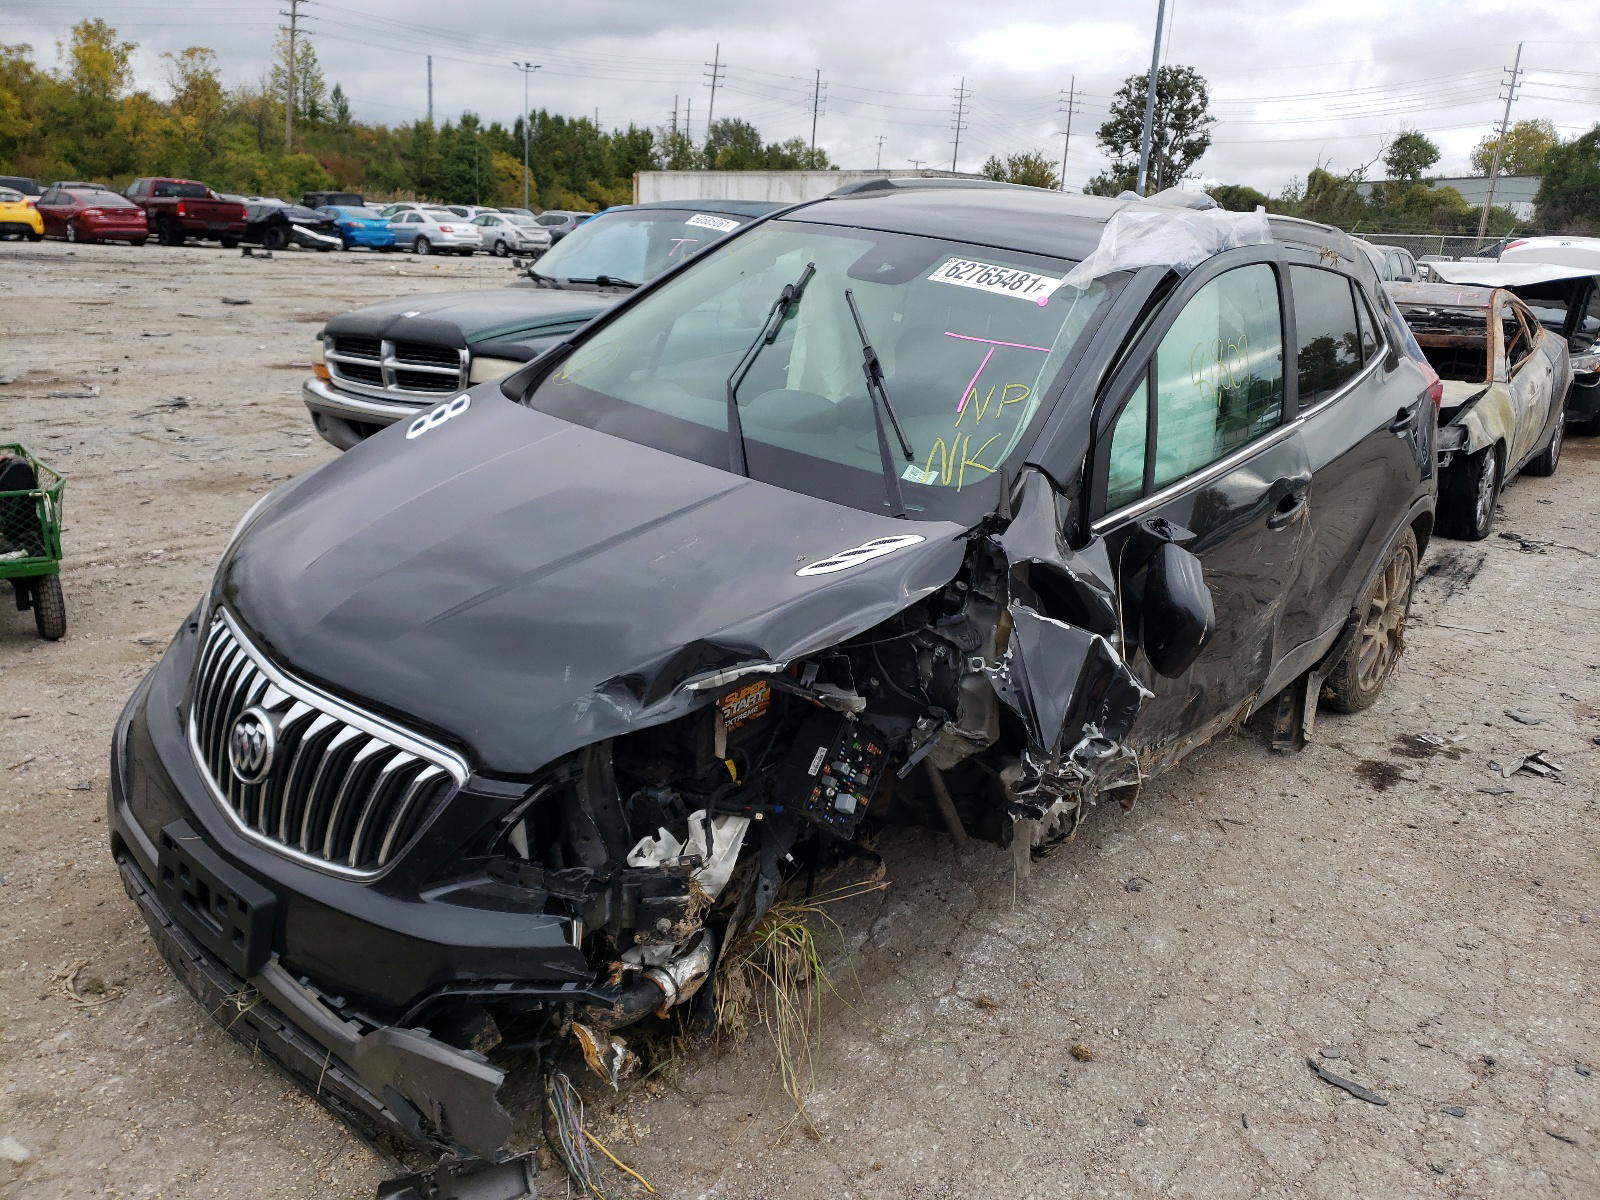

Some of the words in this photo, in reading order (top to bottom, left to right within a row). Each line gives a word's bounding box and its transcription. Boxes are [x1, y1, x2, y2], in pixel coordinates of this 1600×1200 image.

[944, 331, 1053, 413] T
[955, 384, 1031, 427] NP
[921, 432, 1001, 492] NK
[722, 688, 767, 719] START
[724, 680, 767, 704] SUPER
